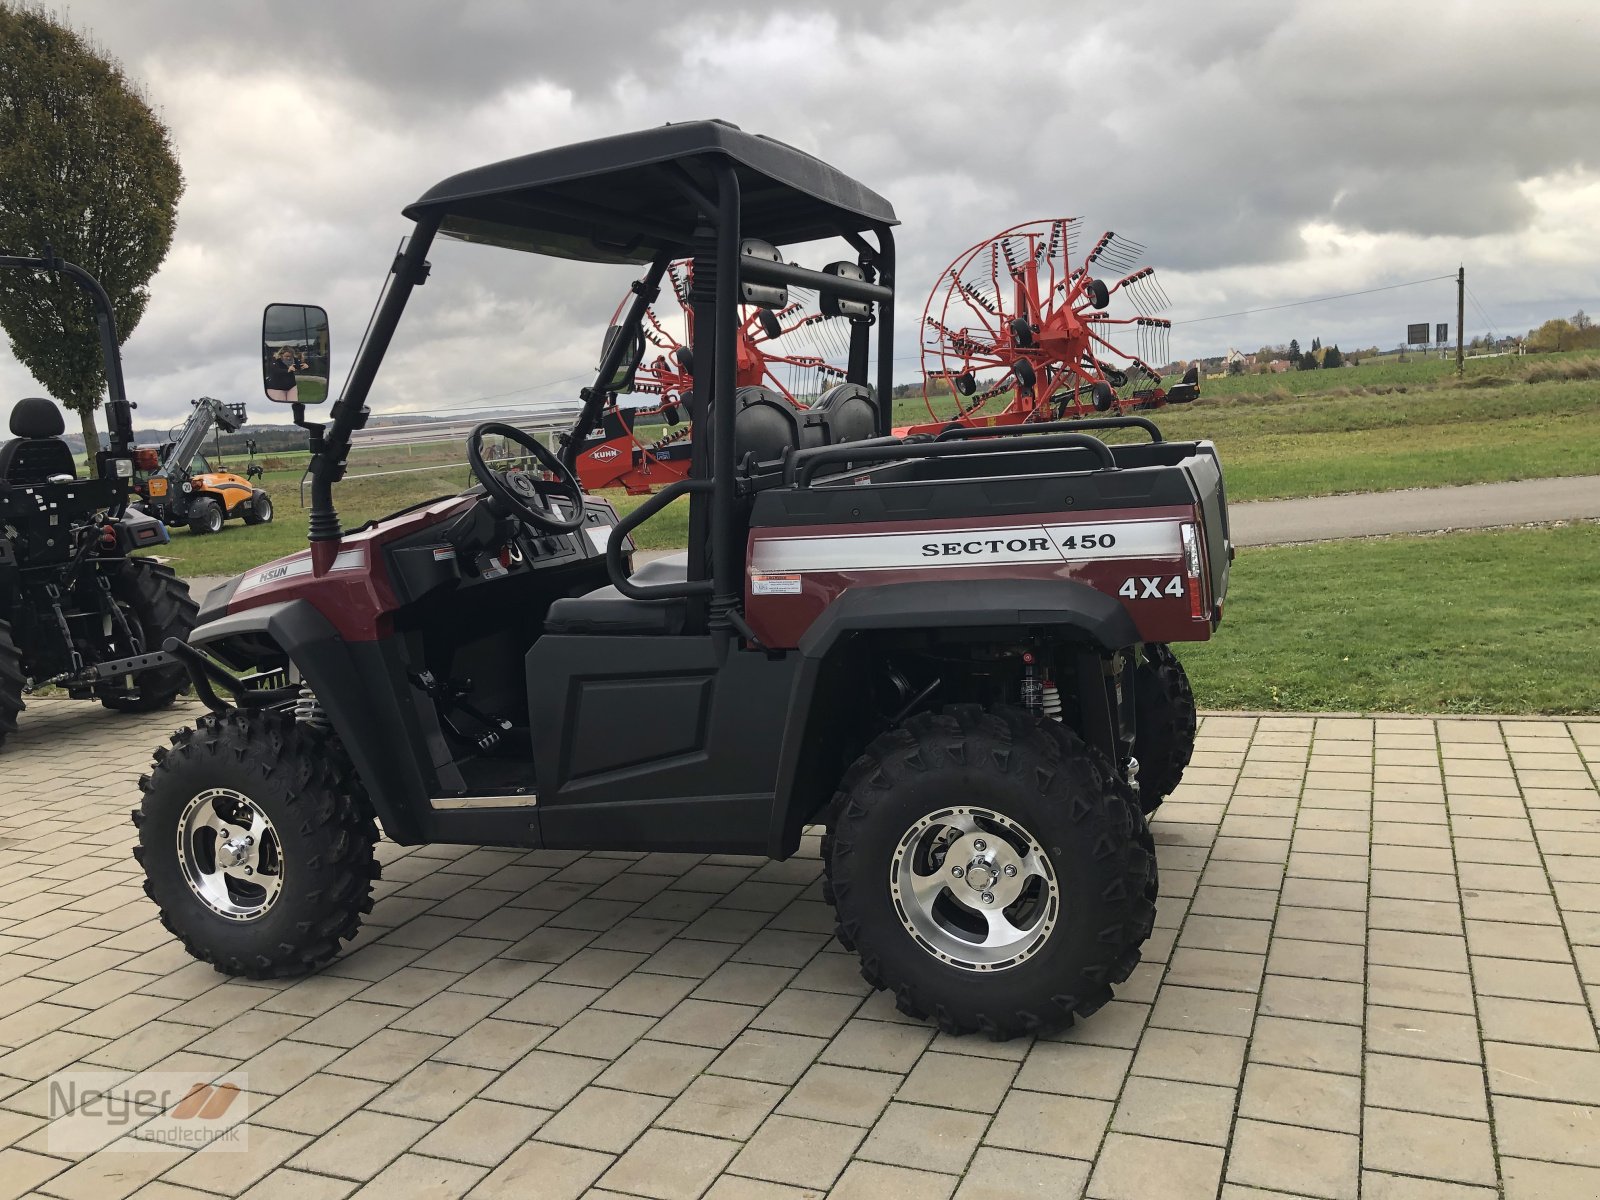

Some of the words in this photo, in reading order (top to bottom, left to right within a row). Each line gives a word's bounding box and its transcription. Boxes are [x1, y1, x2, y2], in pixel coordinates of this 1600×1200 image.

[594, 450, 617, 459] KUHN
[922, 537, 1050, 557] SECTOR
[1062, 533, 1116, 550] 450
[1118, 575, 1185, 599] 4X4
